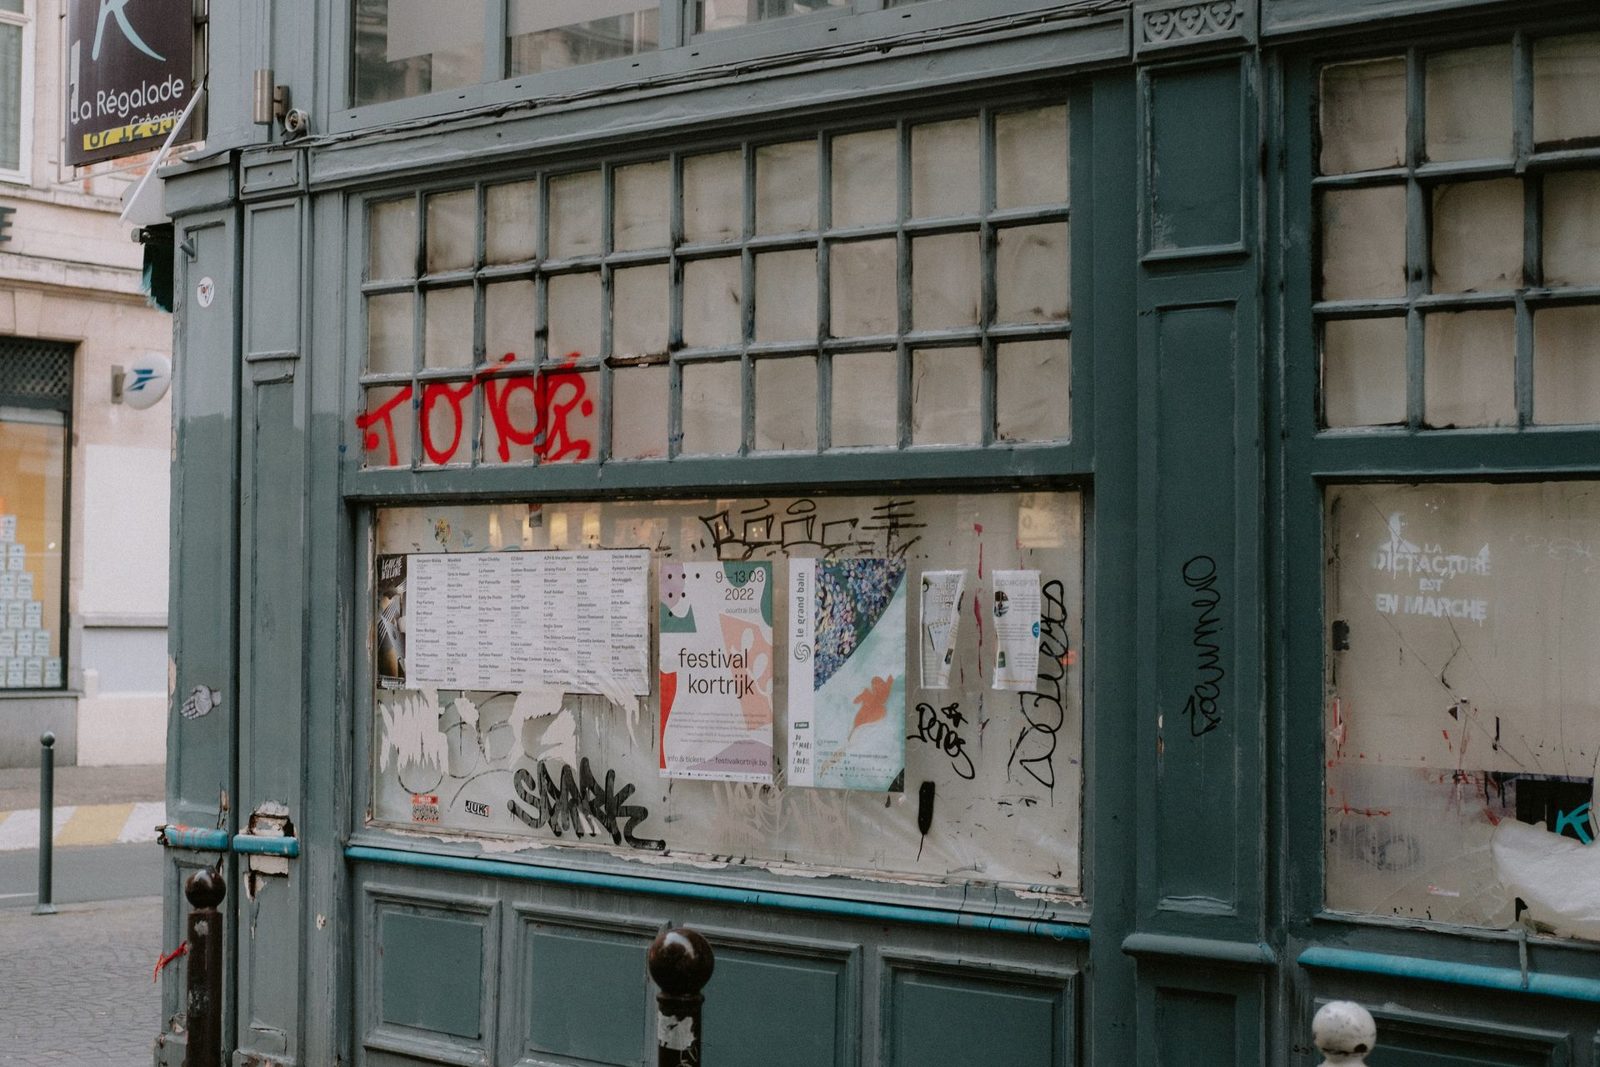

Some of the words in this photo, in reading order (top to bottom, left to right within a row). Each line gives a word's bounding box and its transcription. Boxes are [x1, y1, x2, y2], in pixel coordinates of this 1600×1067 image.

[96, 74, 184, 118] Régalade
[1424, 543, 1442, 554] LA
[796, 572, 805, 593] bain
[725, 588, 754, 600] 2022
[796, 597, 806, 625] grand
[796, 628, 804, 638] le
[678, 647, 748, 669] festival
[688, 673, 755, 699] kortrijk
